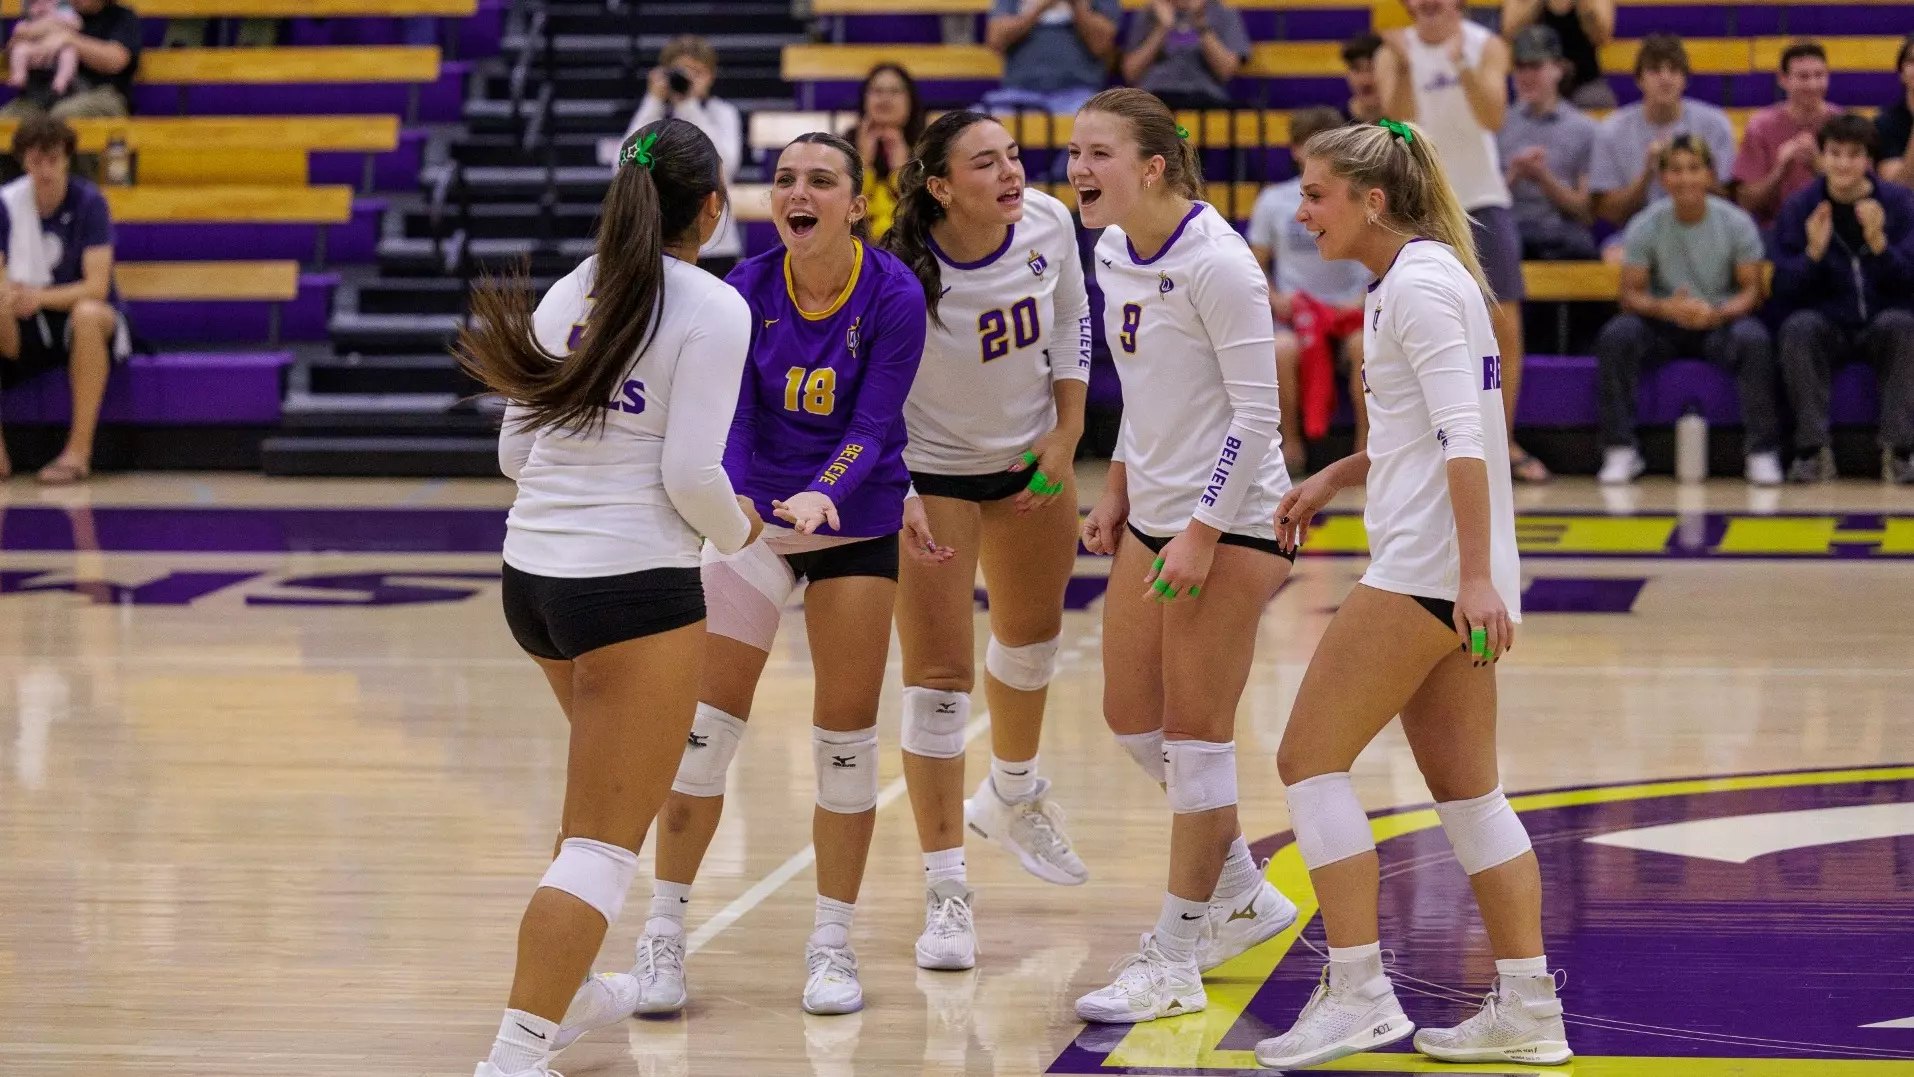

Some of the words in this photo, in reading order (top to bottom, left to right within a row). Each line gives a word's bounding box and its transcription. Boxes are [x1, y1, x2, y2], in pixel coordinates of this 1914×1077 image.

[977, 295, 1041, 364] 20
[1078, 314, 1092, 370] ELIEVE
[1120, 302, 1142, 354] 9
[784, 366, 836, 416] 18
[818, 443, 863, 486] BELIEVE
[1200, 435, 1242, 507] BELIEVE
